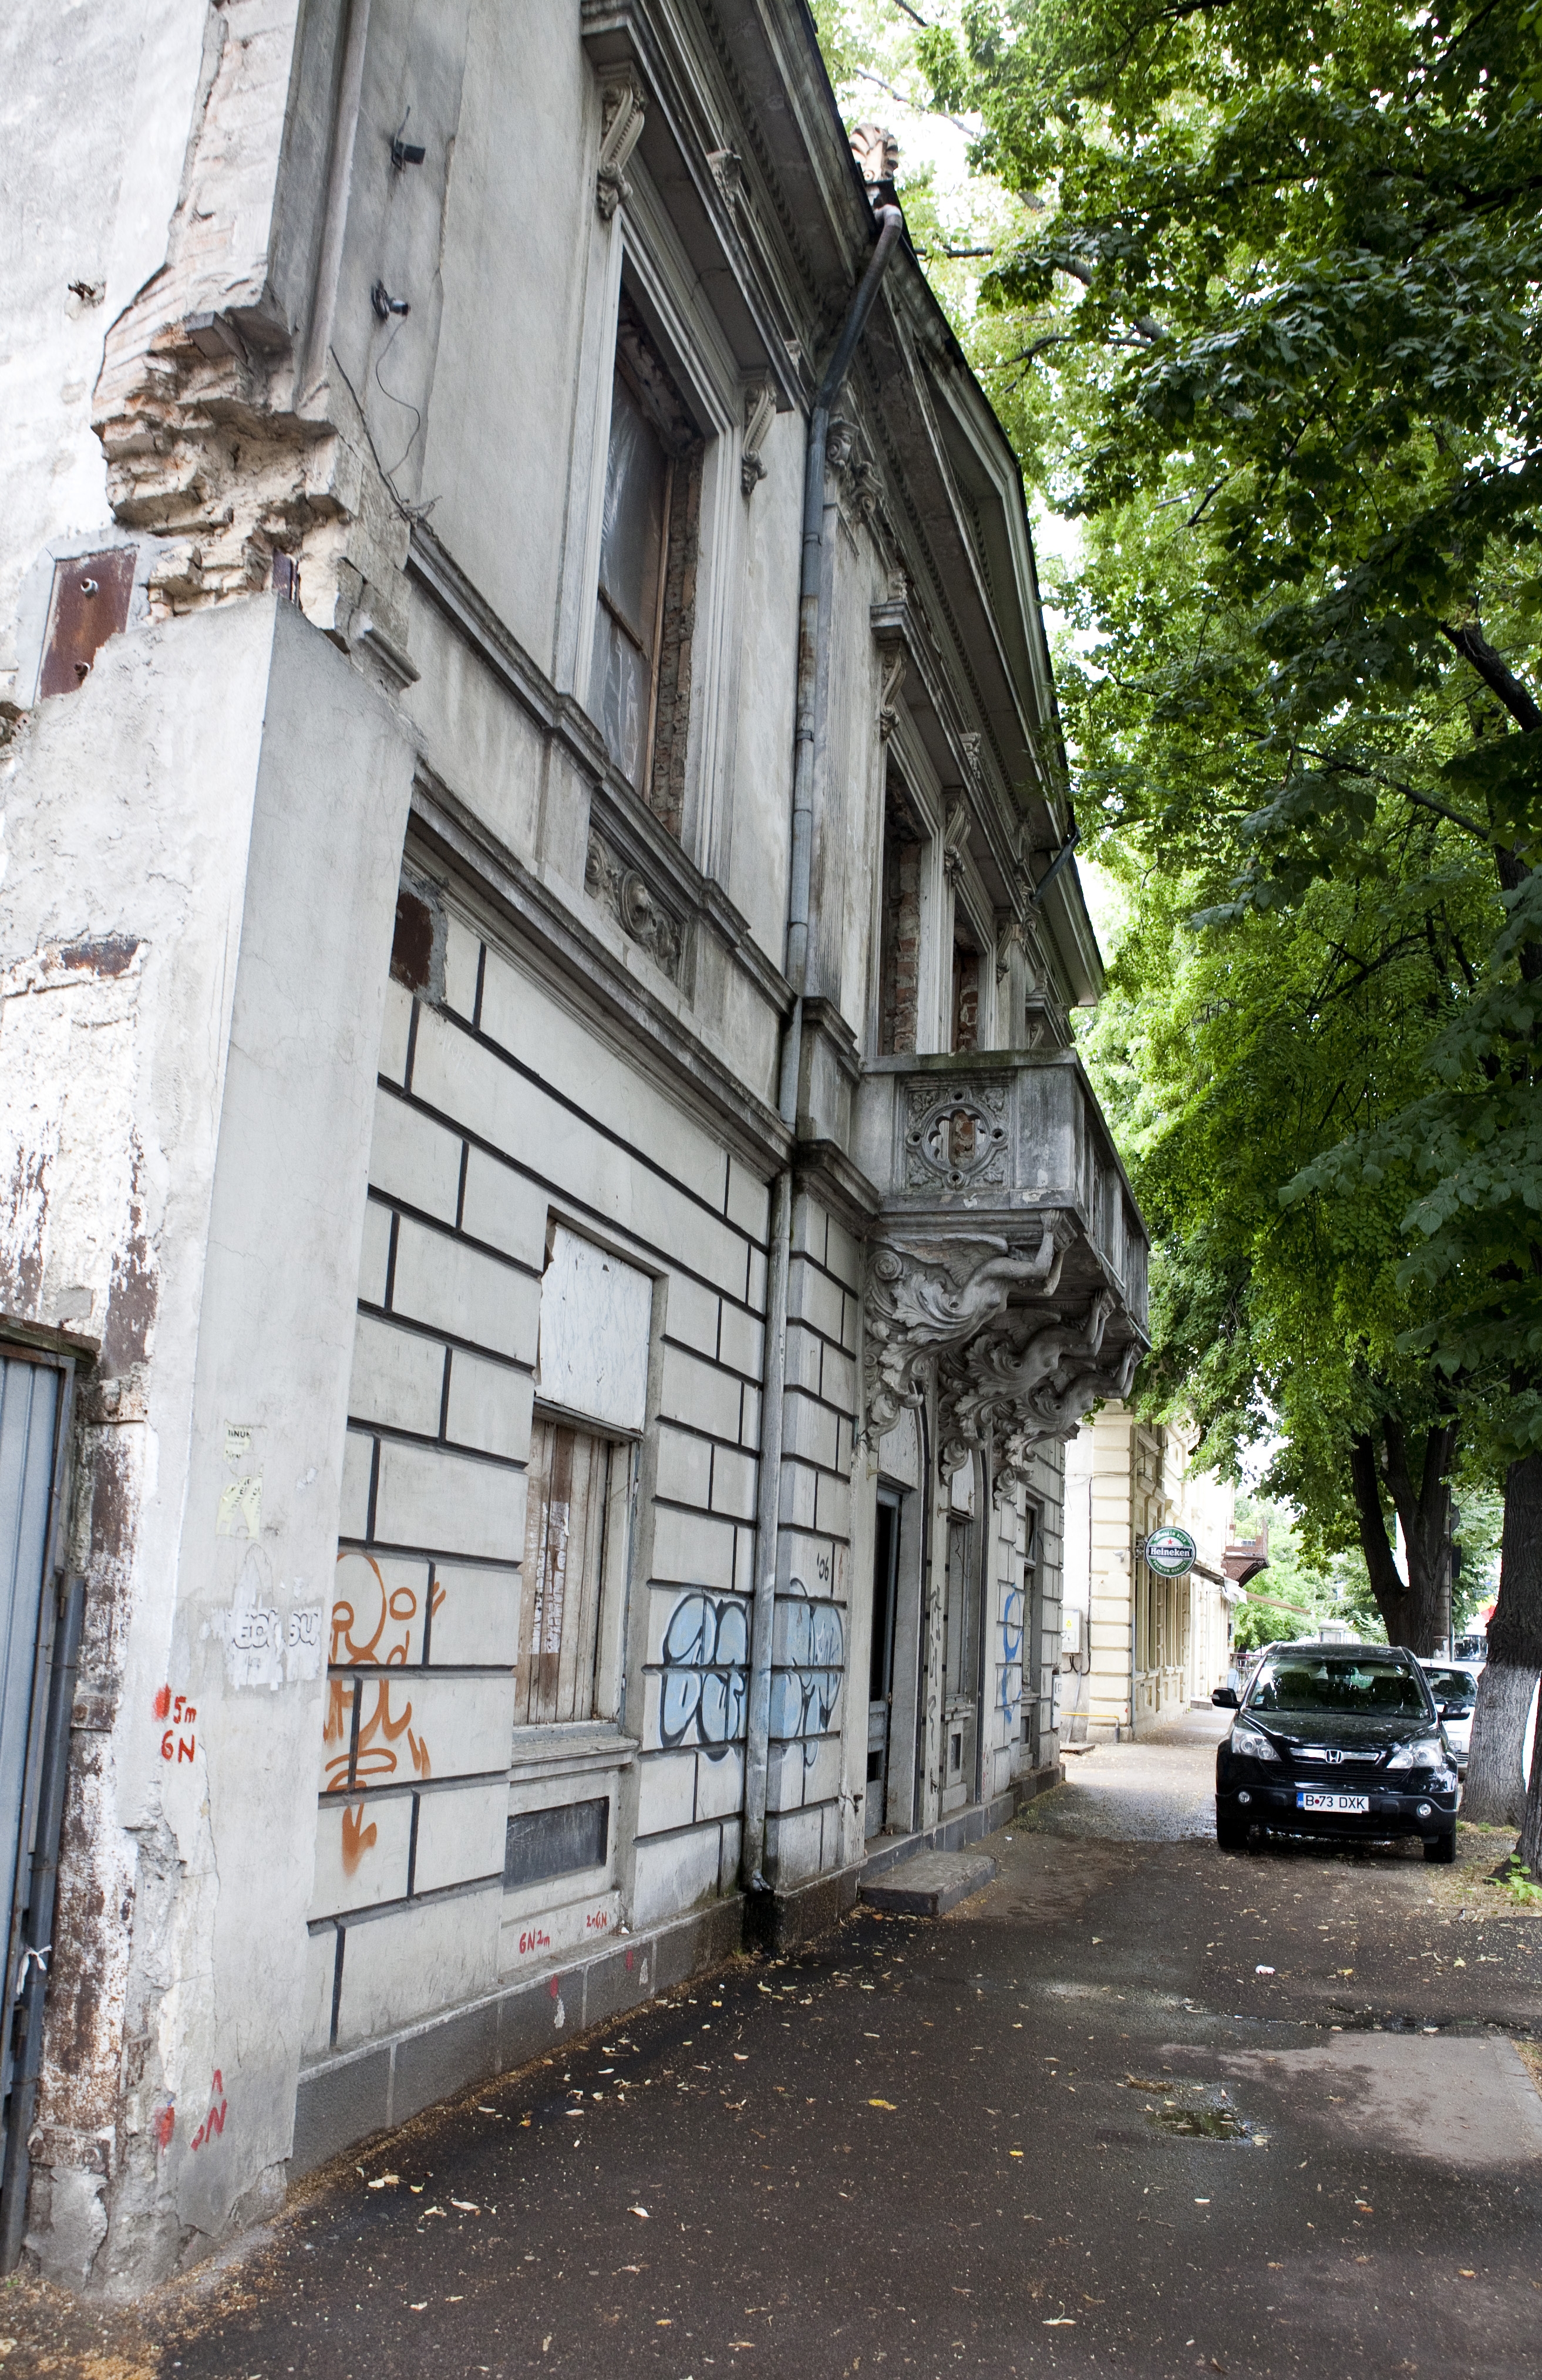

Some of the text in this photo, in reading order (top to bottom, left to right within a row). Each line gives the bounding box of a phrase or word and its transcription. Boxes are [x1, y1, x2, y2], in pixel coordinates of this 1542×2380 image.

[1150, 1547, 1190, 1557] Heineken
[1153, 1560, 1187, 1573] PREMIUM QUALITY
[1339, 1797, 1366, 1809] DXK
